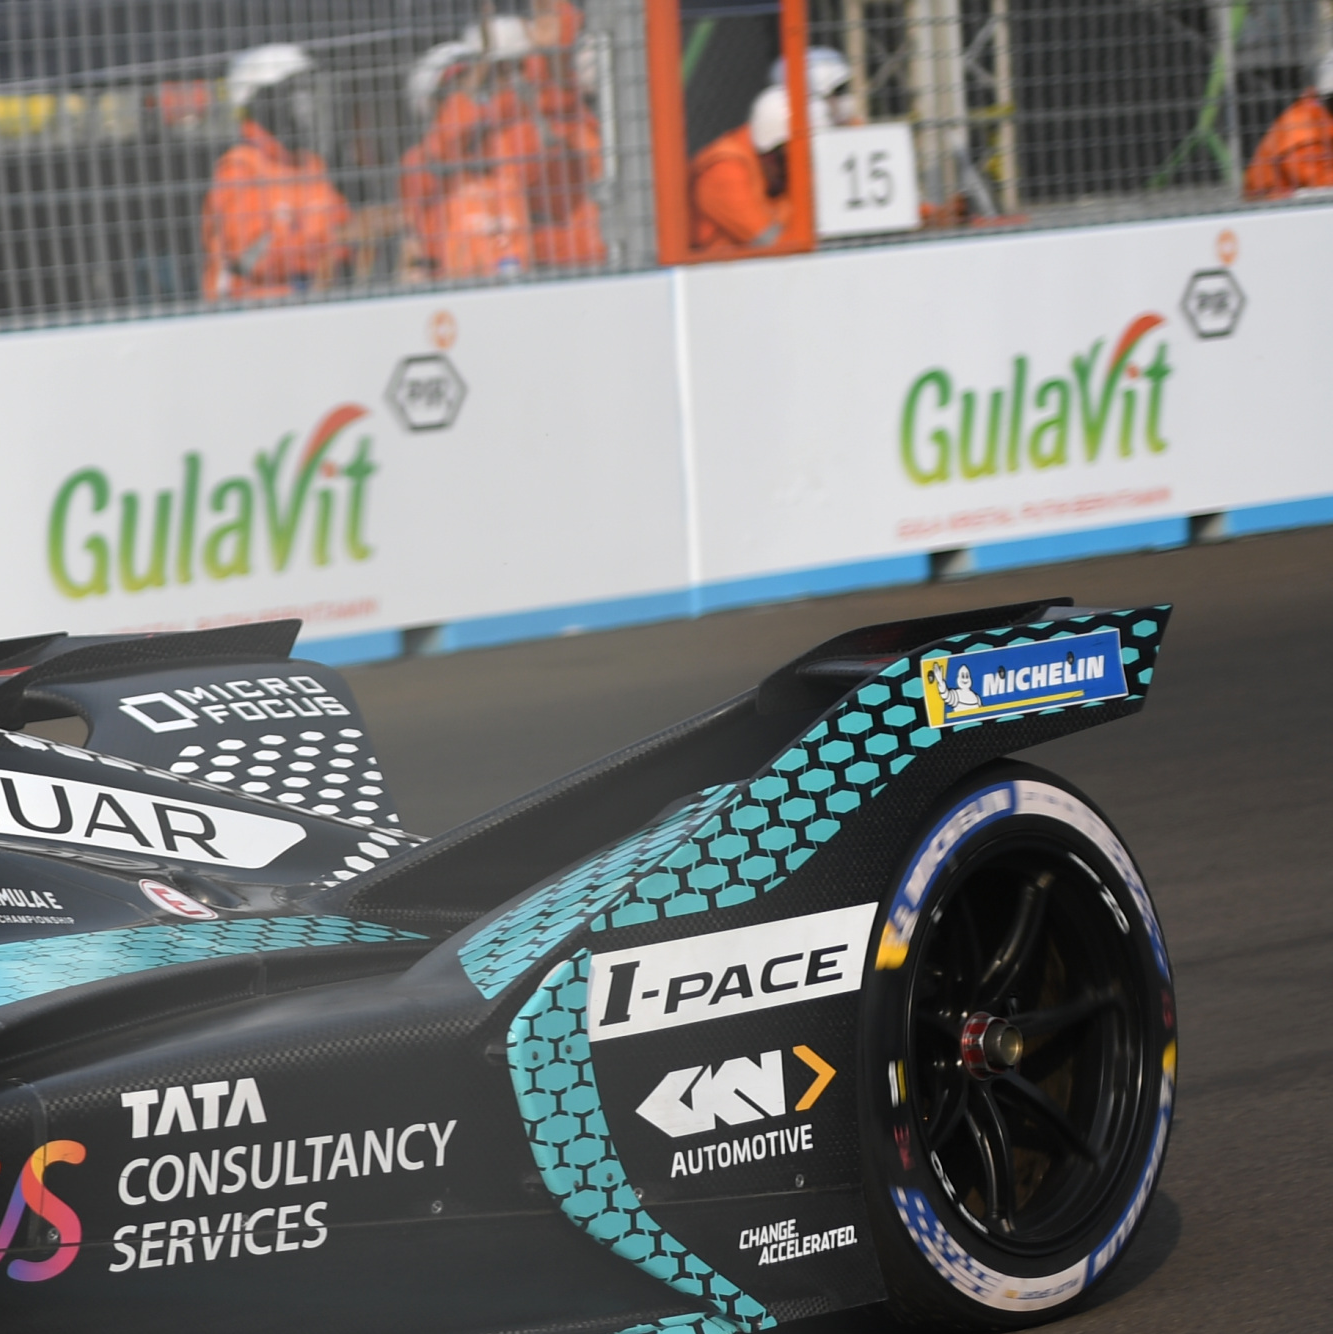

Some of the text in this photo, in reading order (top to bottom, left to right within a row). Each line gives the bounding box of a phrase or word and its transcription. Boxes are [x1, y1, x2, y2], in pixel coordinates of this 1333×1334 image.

[841, 151, 894, 210] 15
[899, 312, 1173, 487] GulaVit
[46, 403, 379, 600] GulaVit
[174, 675, 327, 706] MICRO
[981, 654, 1106, 697] MICHELIN
[200, 696, 351, 725] FOCUS
[44, 892, 63, 910] E
[599, 943, 849, 1027] I-PACE
[121, 1077, 268, 1139] TATA
[118, 1119, 458, 1206] CONSULTANCY
[671, 1123, 815, 1178] AUTOMOTIVE
[109, 1200, 329, 1273] SERVICES
[739, 1218, 800, 1251] CHANGE.
[758, 1227, 859, 1266] ACCELERATED.
